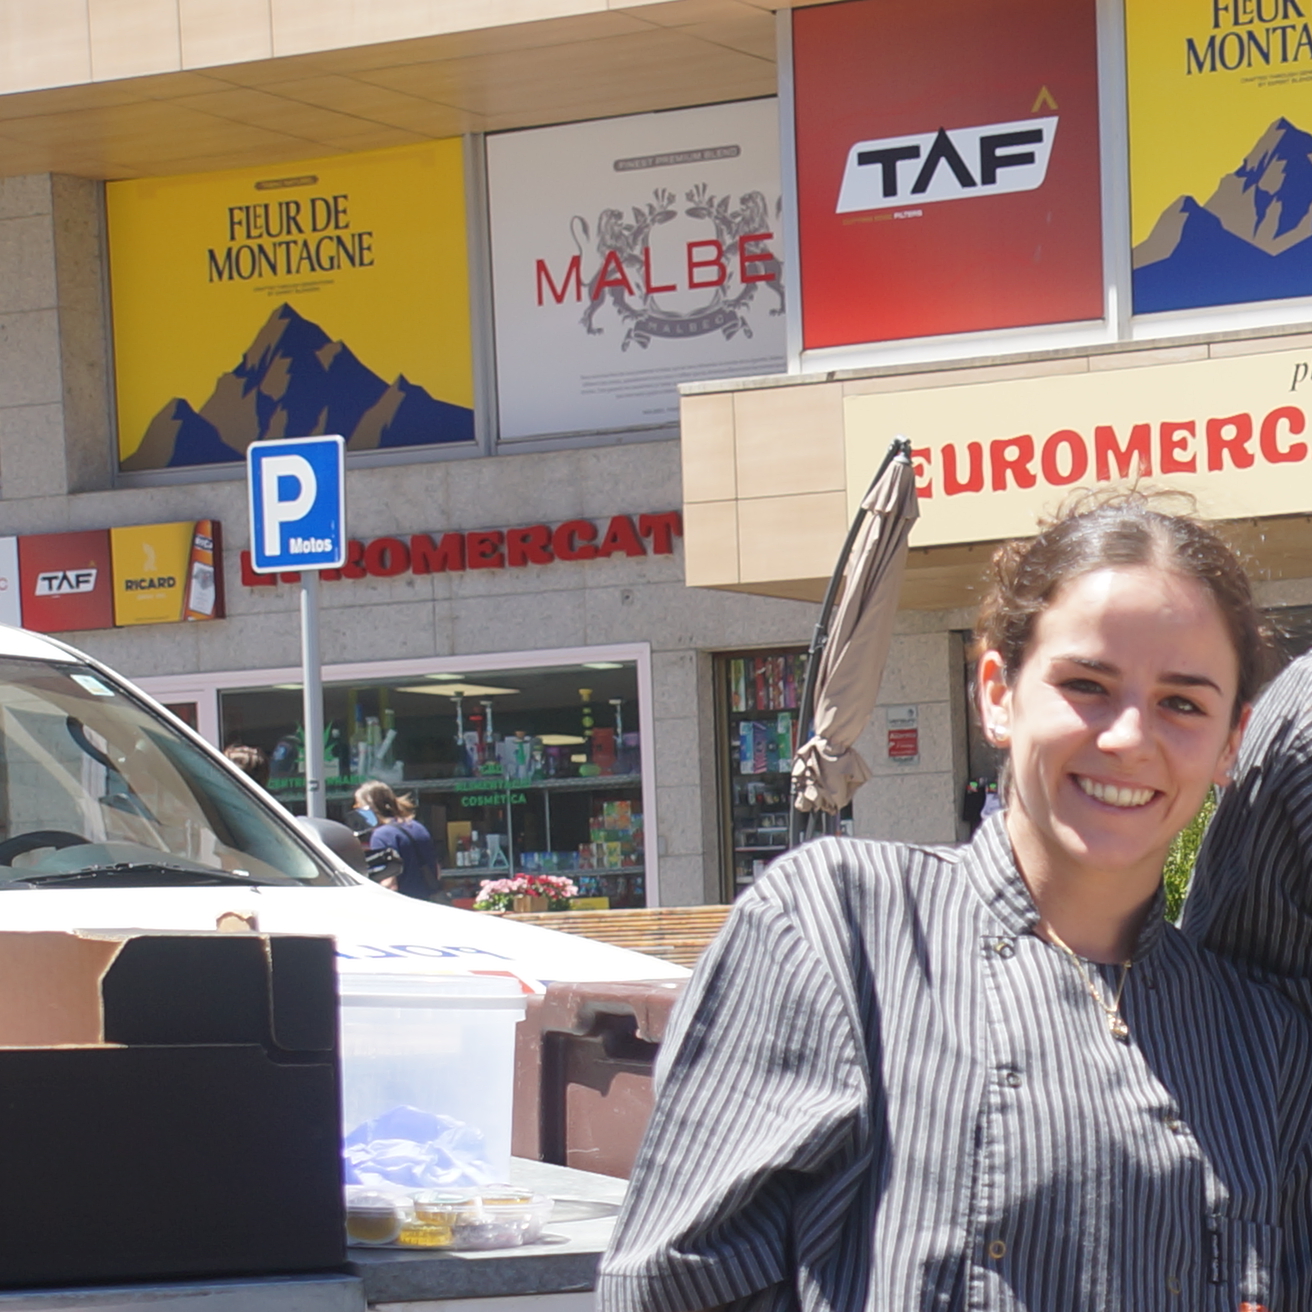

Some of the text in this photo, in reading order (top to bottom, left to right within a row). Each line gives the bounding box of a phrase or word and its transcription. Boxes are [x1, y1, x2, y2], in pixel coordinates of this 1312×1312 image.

[857, 126, 1044, 198] TAF
[228, 194, 350, 242] FLEUR DE
[207, 231, 375, 283] MONTAGNE
[535, 232, 777, 307] MALBE
[261, 454, 317, 557] P
[289, 537, 333, 554] Motos
[40, 570, 93, 592] TAF
[124, 576, 177, 592] RICARD
